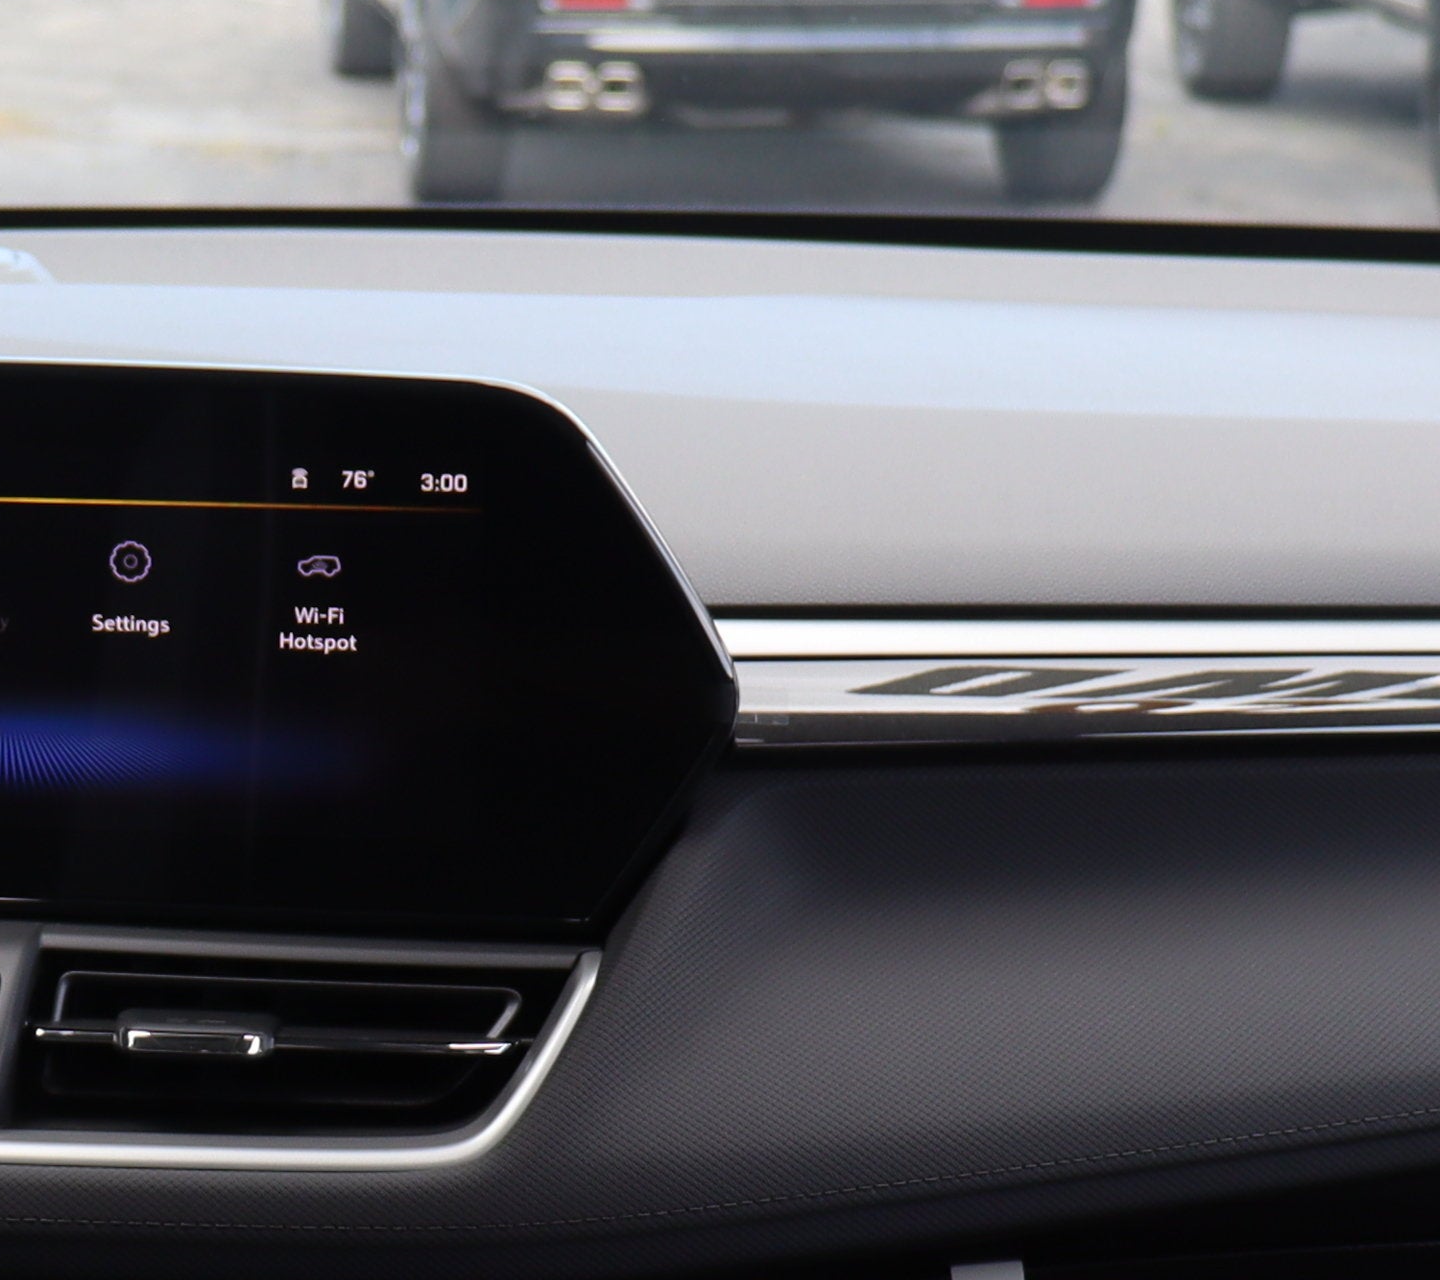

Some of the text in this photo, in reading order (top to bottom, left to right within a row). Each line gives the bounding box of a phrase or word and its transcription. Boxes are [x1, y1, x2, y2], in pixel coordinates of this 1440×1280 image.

[342, 469, 468, 493] 76° 3:00
[91, 613, 171, 637] Settings
[294, 606, 345, 625] Wi-Fi
[279, 632, 358, 655] Hotspot
